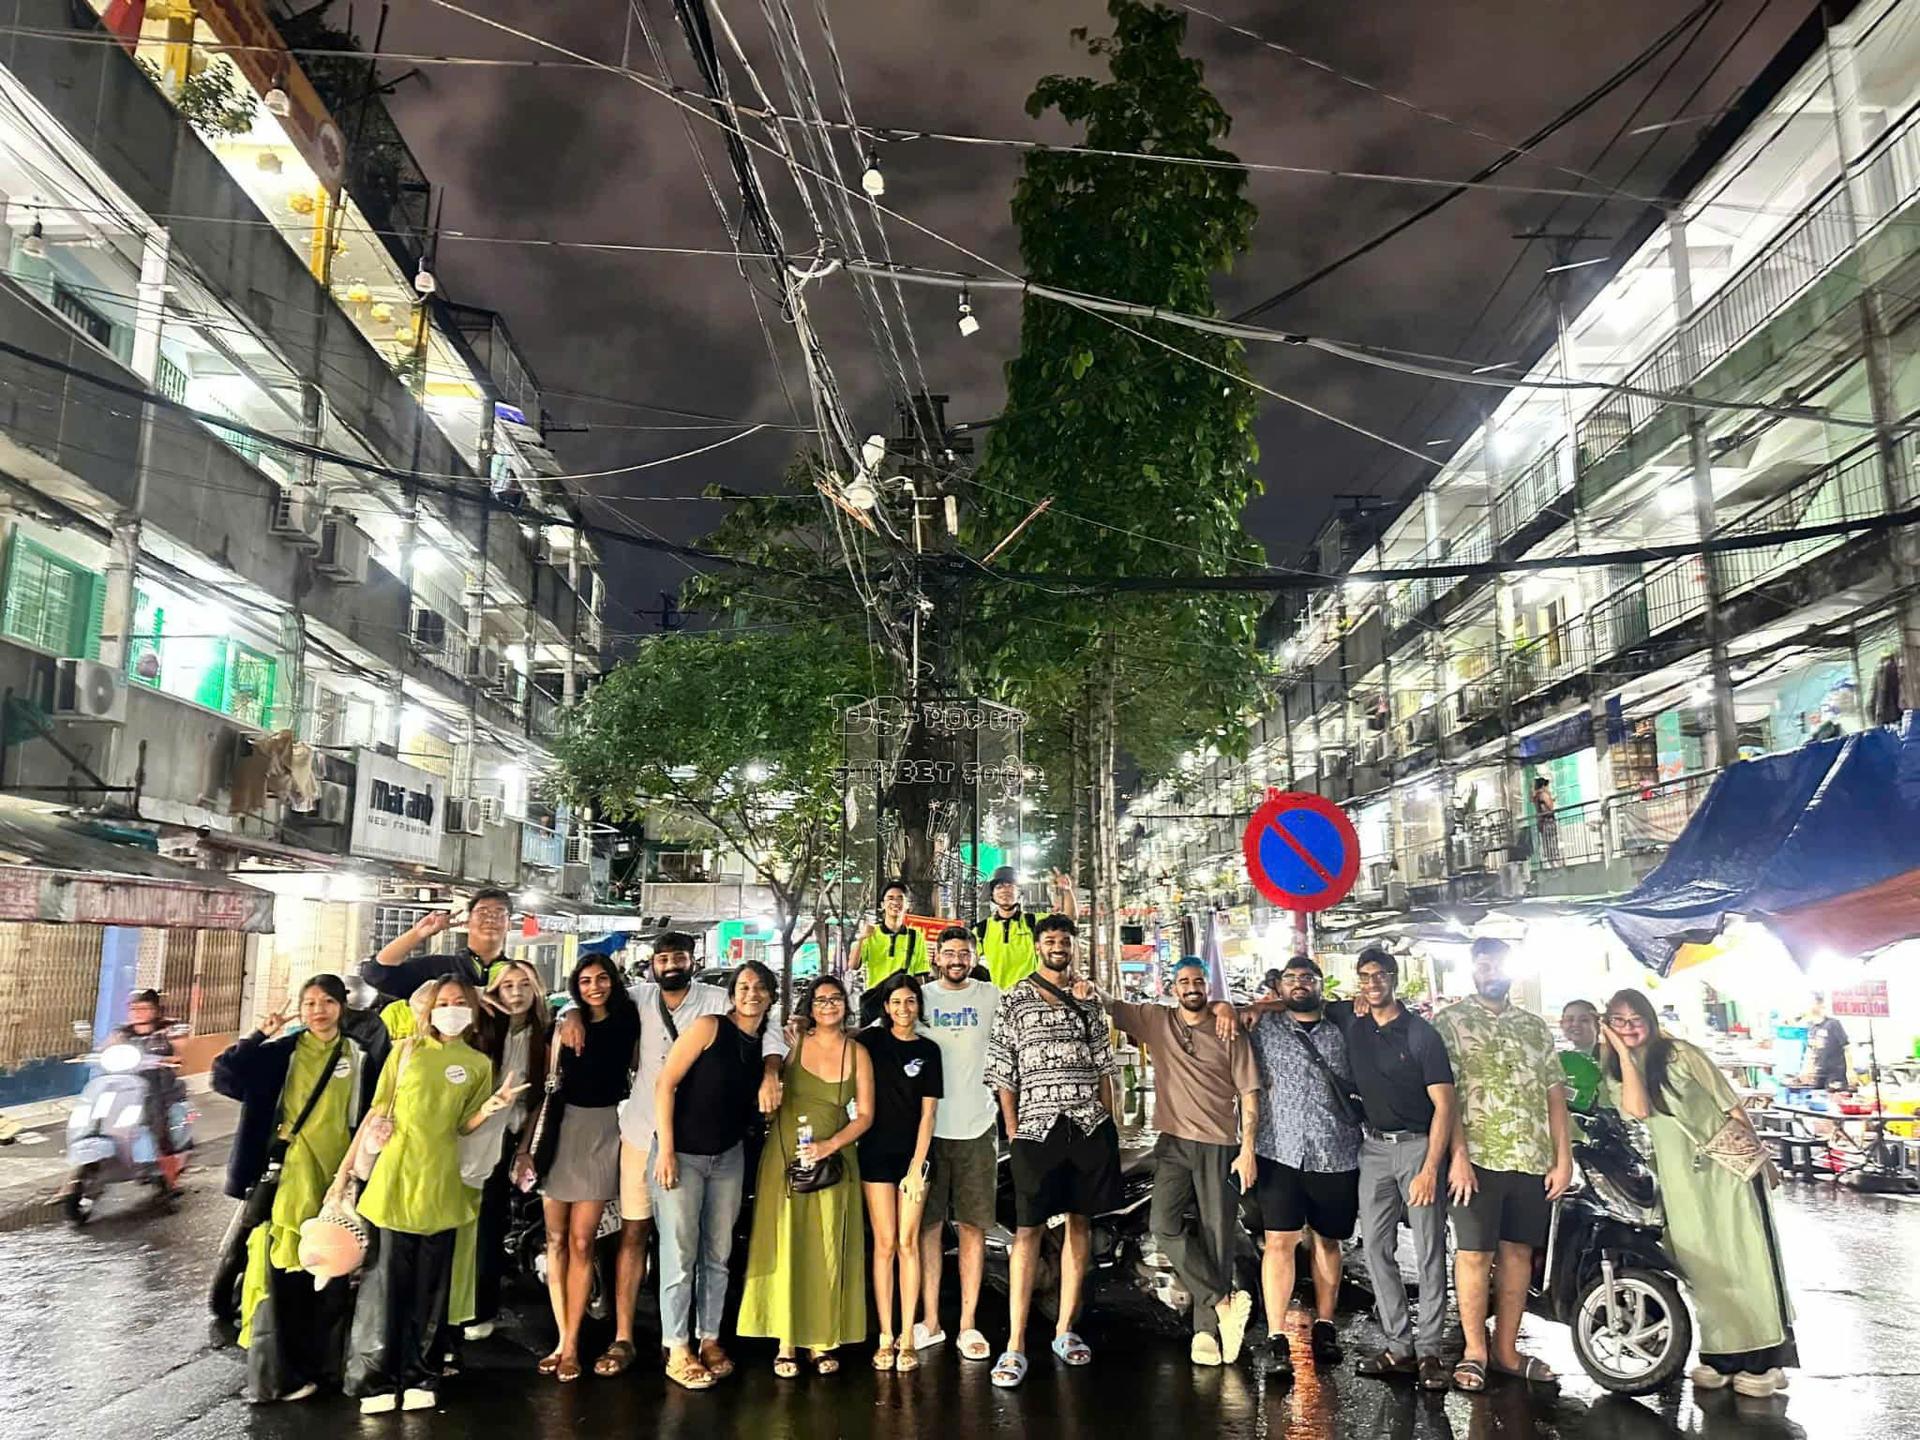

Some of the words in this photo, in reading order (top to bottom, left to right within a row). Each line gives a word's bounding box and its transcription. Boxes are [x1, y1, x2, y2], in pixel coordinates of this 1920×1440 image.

[924, 707, 985, 730] POP
[990, 709, 1028, 730] UP
[834, 759, 955, 785] STREET
[962, 757, 1044, 790] FOOD
